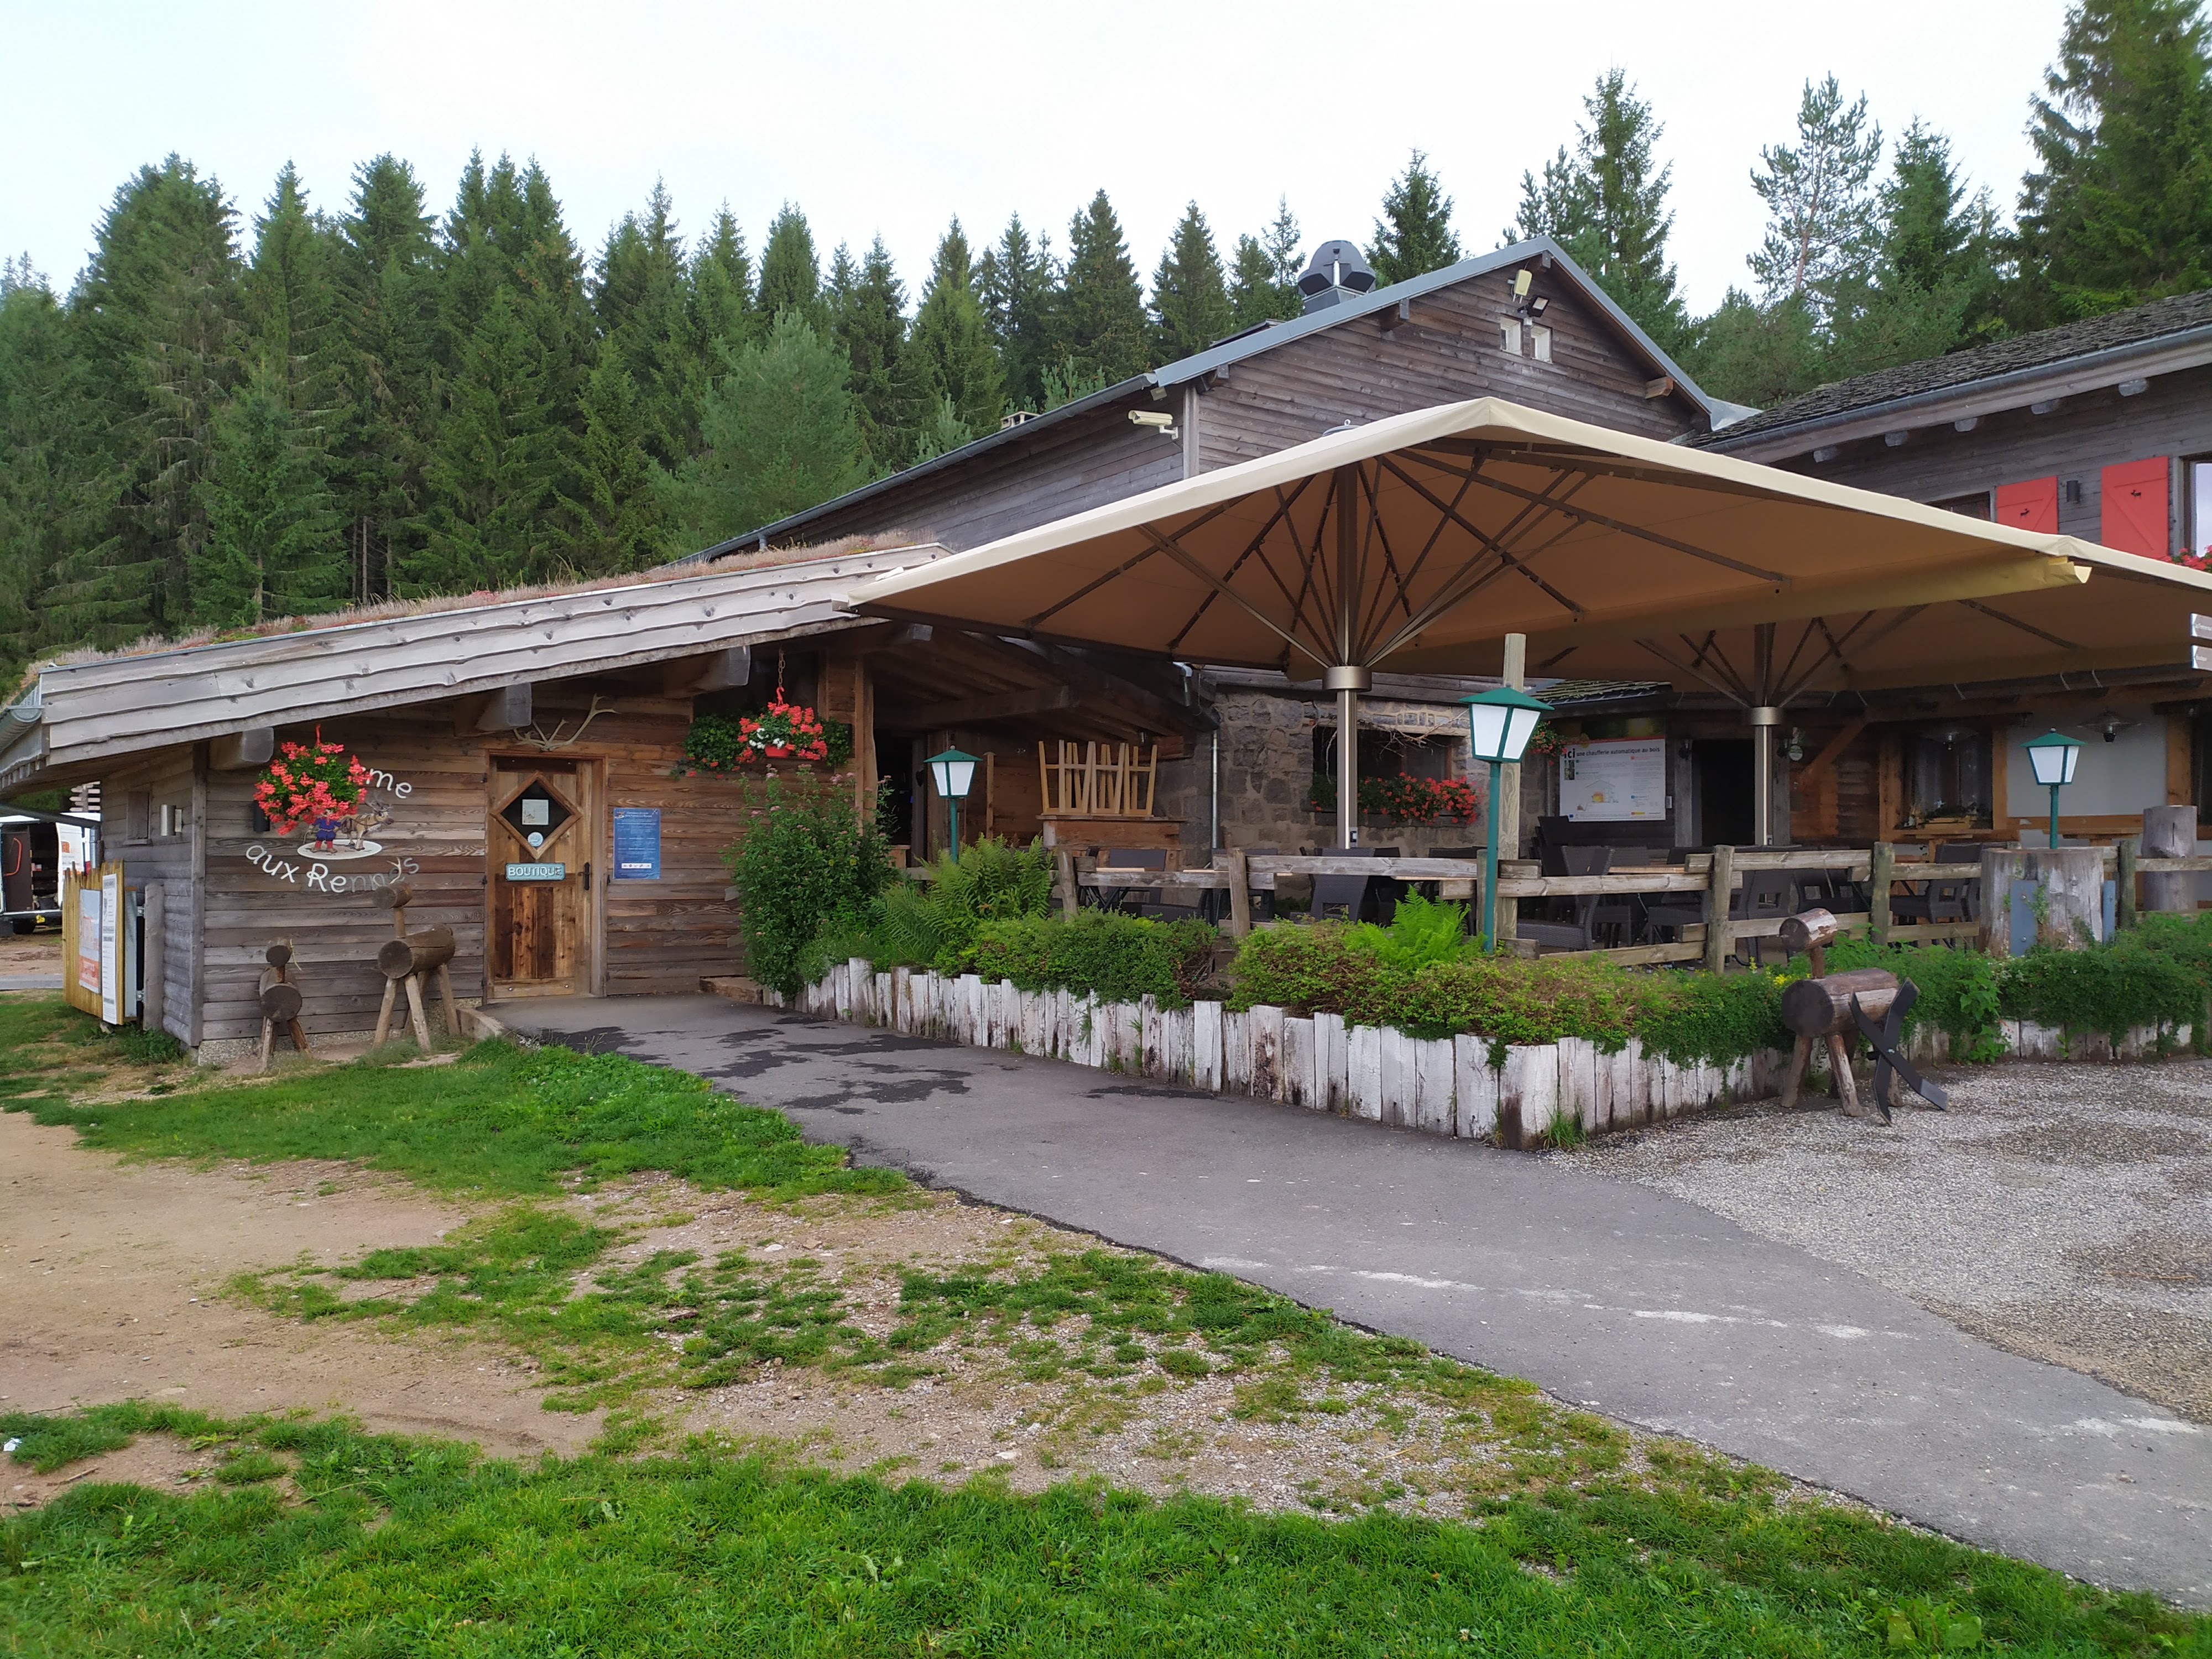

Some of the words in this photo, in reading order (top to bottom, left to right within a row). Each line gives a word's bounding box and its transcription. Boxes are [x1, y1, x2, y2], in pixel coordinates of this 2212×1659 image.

[363, 766, 411, 799] me
[246, 845, 300, 883] aux
[306, 858, 419, 893] Rennes
[508, 867, 562, 877] BOUTIQUE
